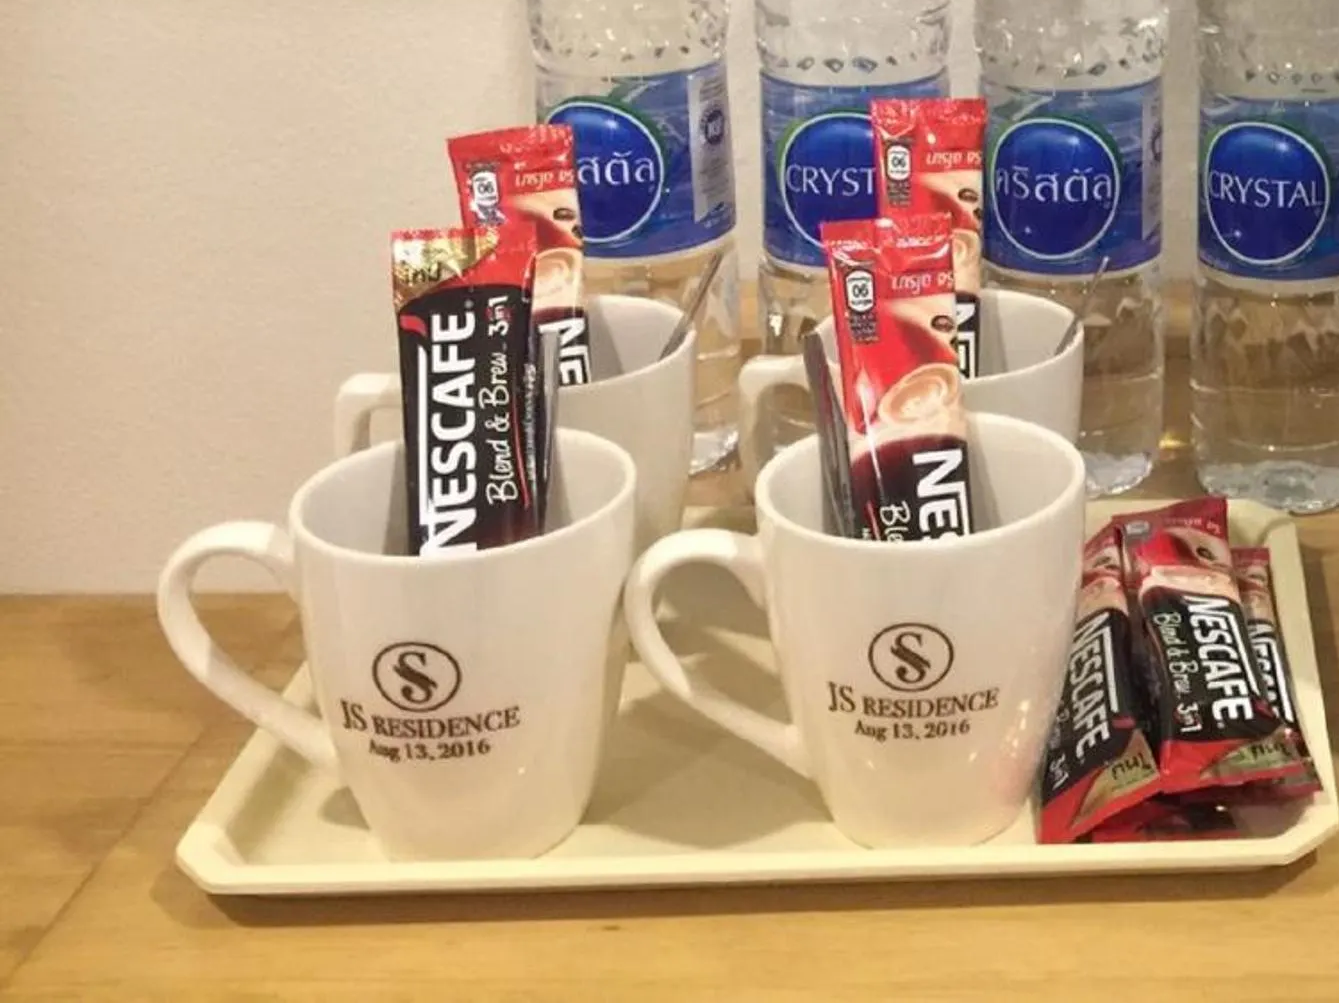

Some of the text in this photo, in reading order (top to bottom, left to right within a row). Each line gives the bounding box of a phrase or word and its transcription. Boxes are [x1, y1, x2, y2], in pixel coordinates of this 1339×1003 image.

[576, 150, 656, 186] สตัล
[785, 162, 876, 197] CRYST
[1208, 169, 1323, 209] CRYSTAL
[484, 413, 510, 432] &
[485, 438, 519, 506] Blend
[339, 697, 521, 740] JS RESIDENCE
[827, 680, 1001, 720] JS RESIDENCE
[854, 718, 887, 743] Aug
